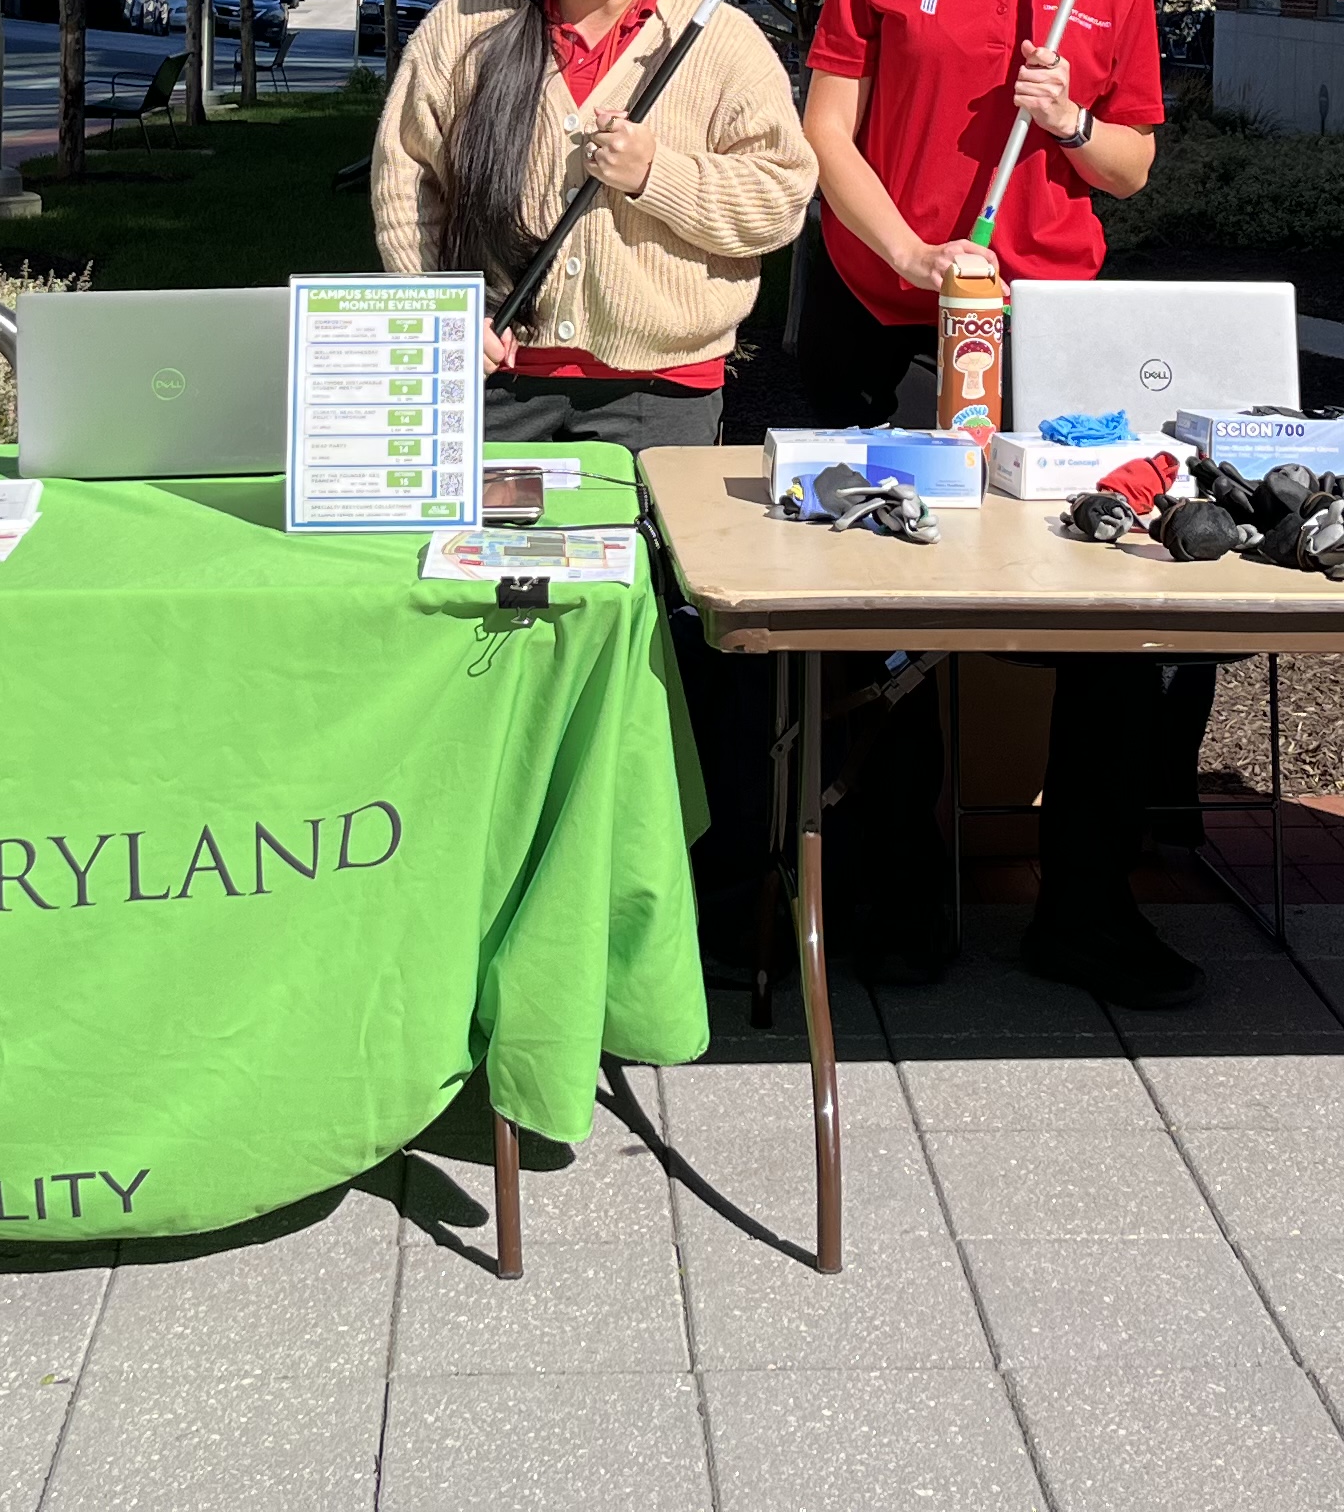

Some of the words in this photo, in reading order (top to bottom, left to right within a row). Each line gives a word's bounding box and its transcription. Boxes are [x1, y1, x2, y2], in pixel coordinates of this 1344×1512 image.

[309, 289, 362, 299] CAMPUS
[364, 289, 466, 299] SUSTAINABILITY
[338, 300, 385, 310] MONTH
[388, 300, 437, 310] EVENTS
[402, 324, 409, 332] 7
[1144, 371, 1169, 379] DELL
[156, 380, 182, 388] DELL
[399, 416, 411, 424] 14
[1216, 422, 1273, 437] SCION
[1275, 424, 1305, 437] 700
[398, 446, 409, 454] 14
[965, 451, 975, 468] S
[1067, 458, 1100, 467] Concept
[399, 478, 409, 486] 15
